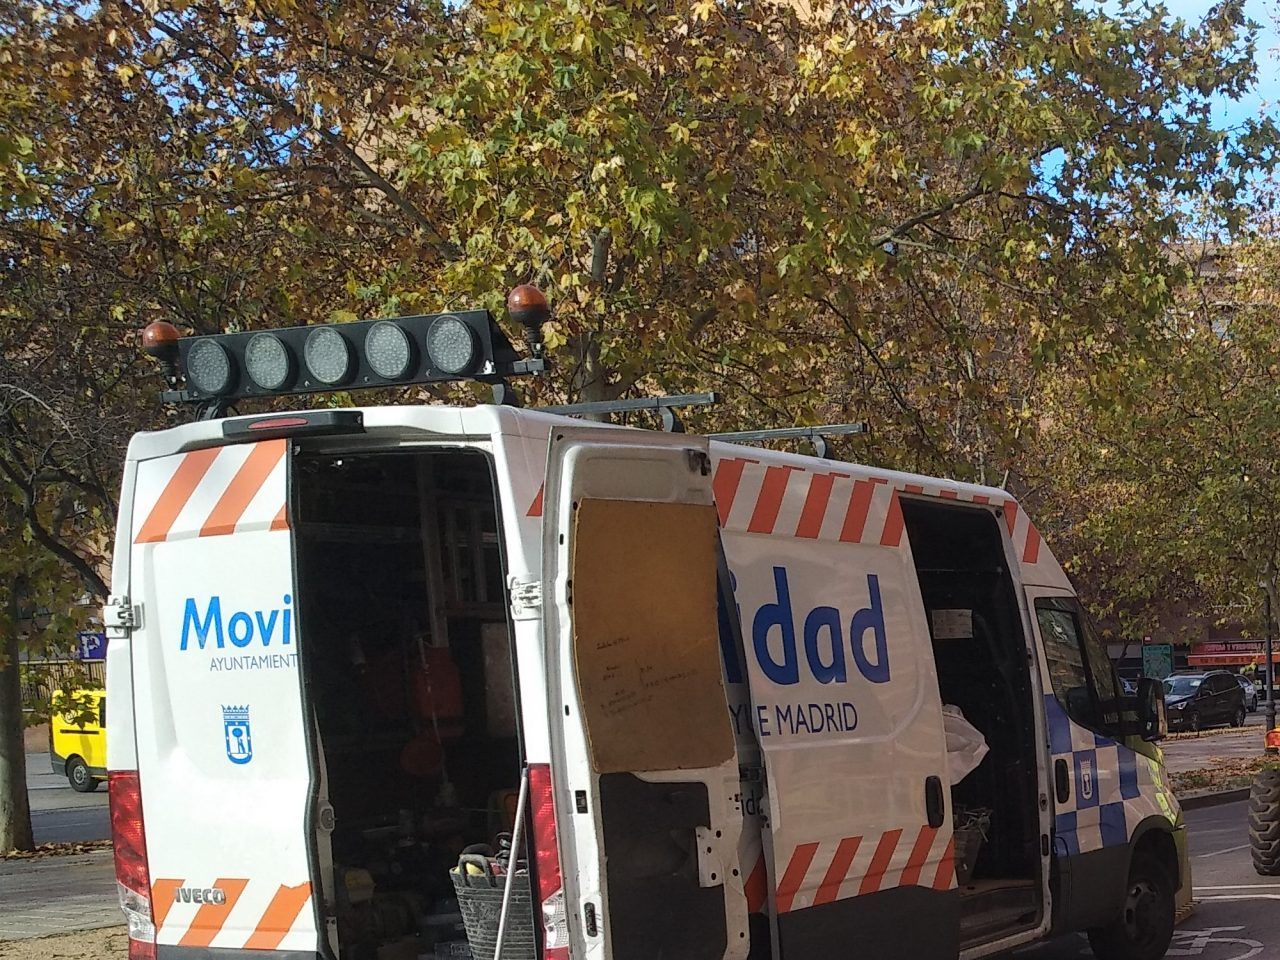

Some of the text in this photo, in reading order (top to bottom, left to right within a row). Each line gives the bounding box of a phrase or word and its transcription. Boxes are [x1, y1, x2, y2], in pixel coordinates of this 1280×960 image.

[180, 593, 291, 650] Movi
[209, 653, 298, 671] AYUNTAMIENT
[775, 702, 858, 736] MADRID
[174, 887, 226, 904] IVECO
